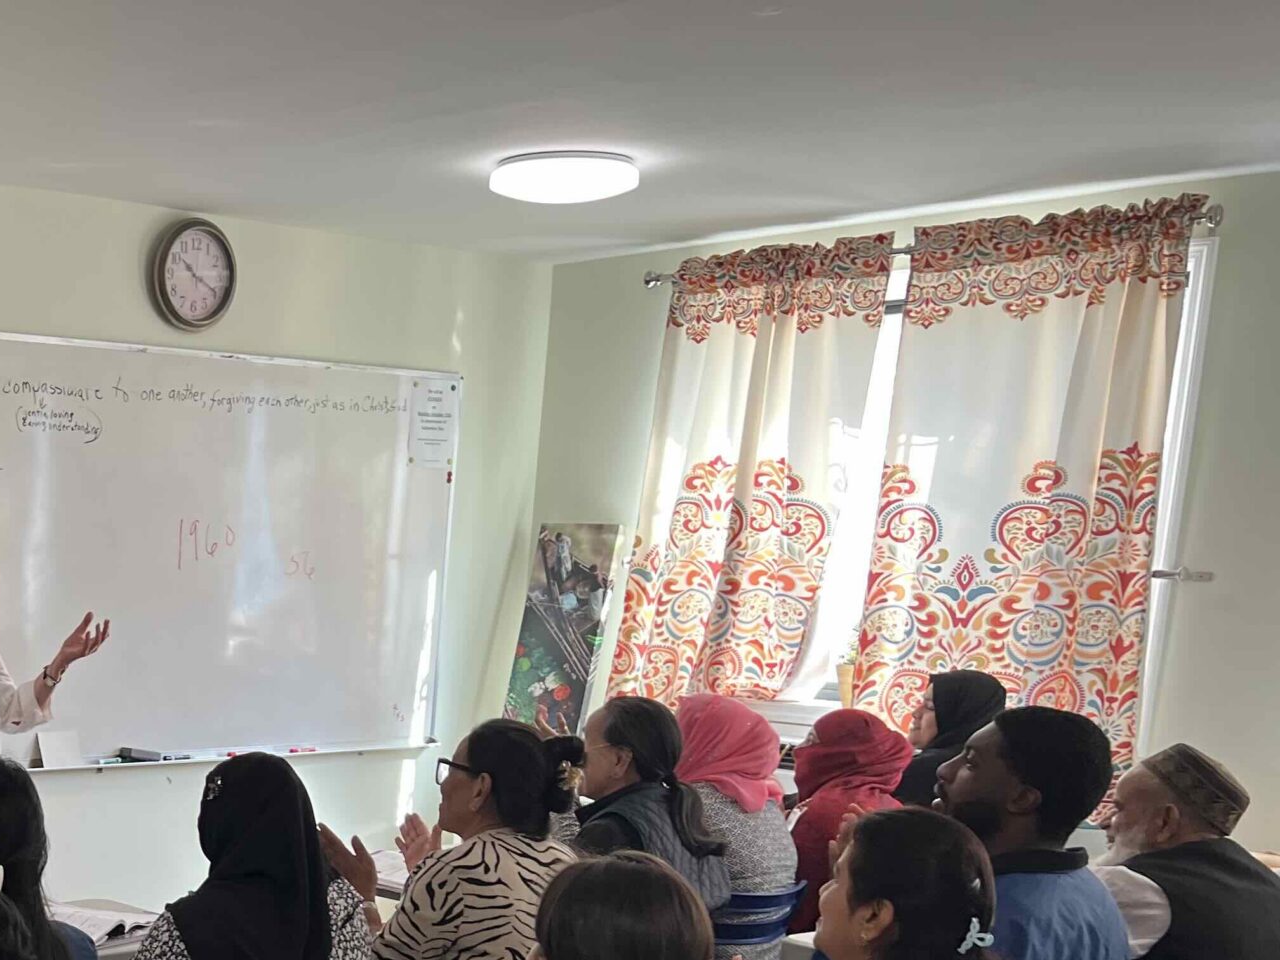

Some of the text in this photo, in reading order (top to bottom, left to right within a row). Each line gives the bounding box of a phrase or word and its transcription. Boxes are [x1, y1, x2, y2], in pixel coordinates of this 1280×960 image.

[180, 240, 188, 254] 11
[191, 237, 202, 251] 12
[171, 251, 181, 265] 10
[167, 267, 174, 280] 9
[170, 284, 177, 297] 8
[179, 296, 186, 308] 7
[190, 301, 197, 313] 6
[112, 376, 130, 403] to
[140, 388, 162, 401] one
[209, 388, 256, 414] forgiving
[332, 401, 345, 411] as
[349, 399, 360, 412] in
[178, 518, 236, 570] 1960
